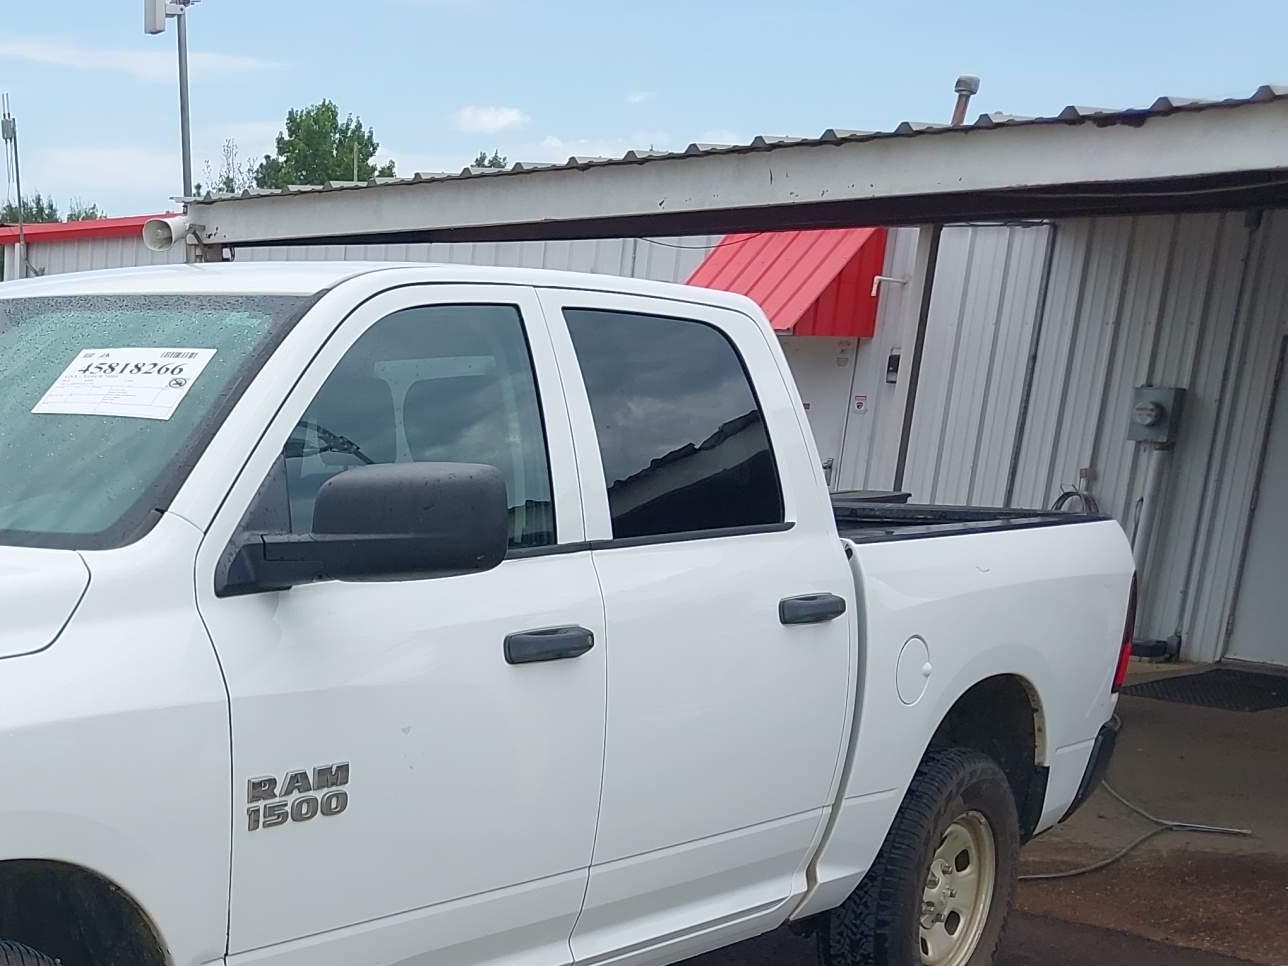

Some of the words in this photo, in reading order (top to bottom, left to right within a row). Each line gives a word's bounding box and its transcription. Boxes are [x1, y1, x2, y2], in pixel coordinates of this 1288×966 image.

[78, 362, 187, 376] 45818266
[247, 761, 350, 804] RAM
[247, 790, 349, 832] 1500
